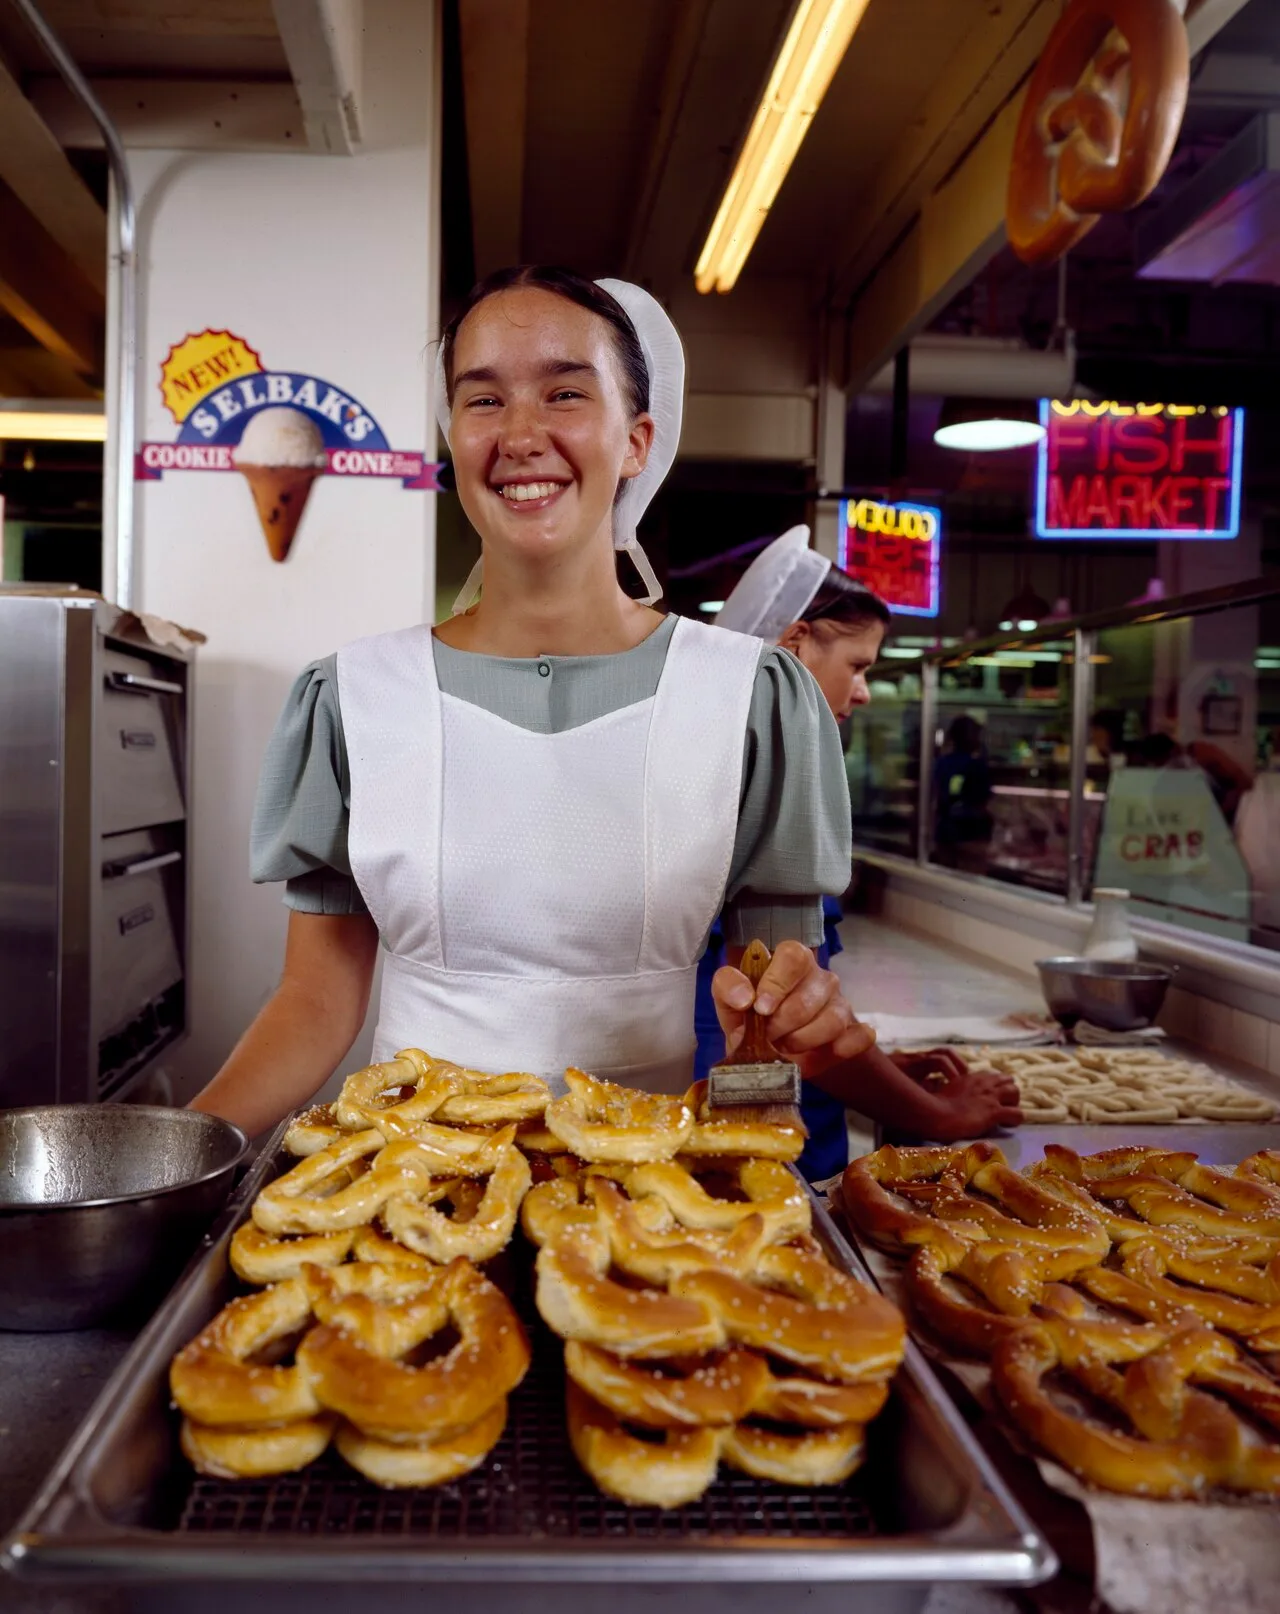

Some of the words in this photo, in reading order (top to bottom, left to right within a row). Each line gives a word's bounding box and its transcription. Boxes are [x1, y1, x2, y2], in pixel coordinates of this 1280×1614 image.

[171, 346, 242, 399] NEW!
[143, 445, 231, 469] COOKIE
[332, 450, 394, 474] CONE
[1049, 415, 1232, 474] FISH
[1047, 474, 1231, 534] MARKET
[1120, 830, 1205, 862] CRAB
